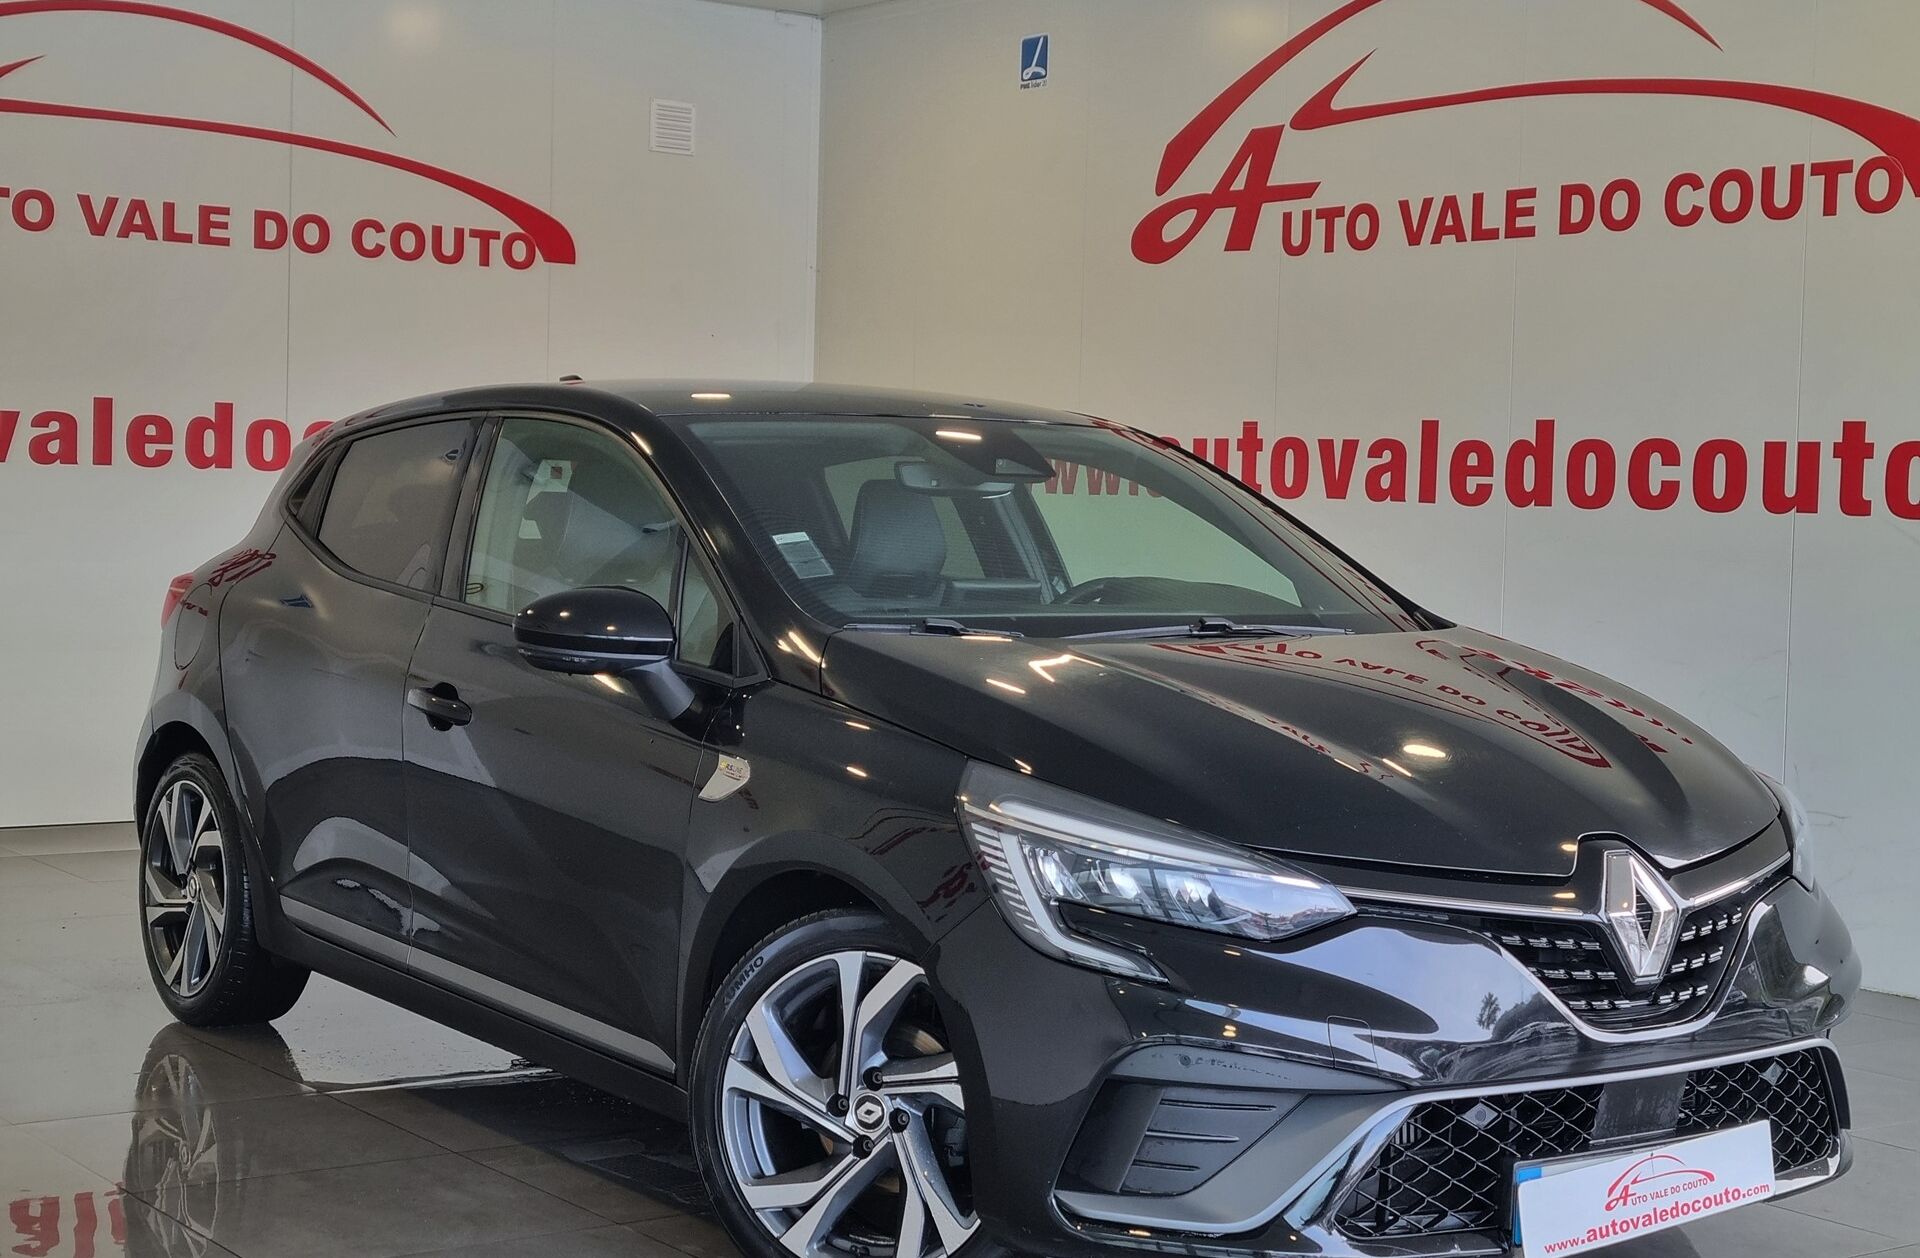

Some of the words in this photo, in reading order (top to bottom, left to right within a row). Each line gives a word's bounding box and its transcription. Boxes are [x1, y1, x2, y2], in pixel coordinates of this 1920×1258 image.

[1130, 124, 1381, 265] AUTO
[1397, 188, 1537, 247] VALE
[1557, 178, 1642, 237] DO
[1663, 155, 1906, 229] COUTO
[76, 193, 231, 248] VALE
[253, 208, 332, 256] DO
[351, 217, 538, 271] COUTO
[1544, 1183, 1770, 1254] www.autovaledocouto.com
[1604, 1184, 1648, 1212] AUTO
[1649, 1187, 1669, 1201] VALE
[1670, 1184, 1681, 1195] DO
[1682, 1177, 1708, 1192] COUTO
